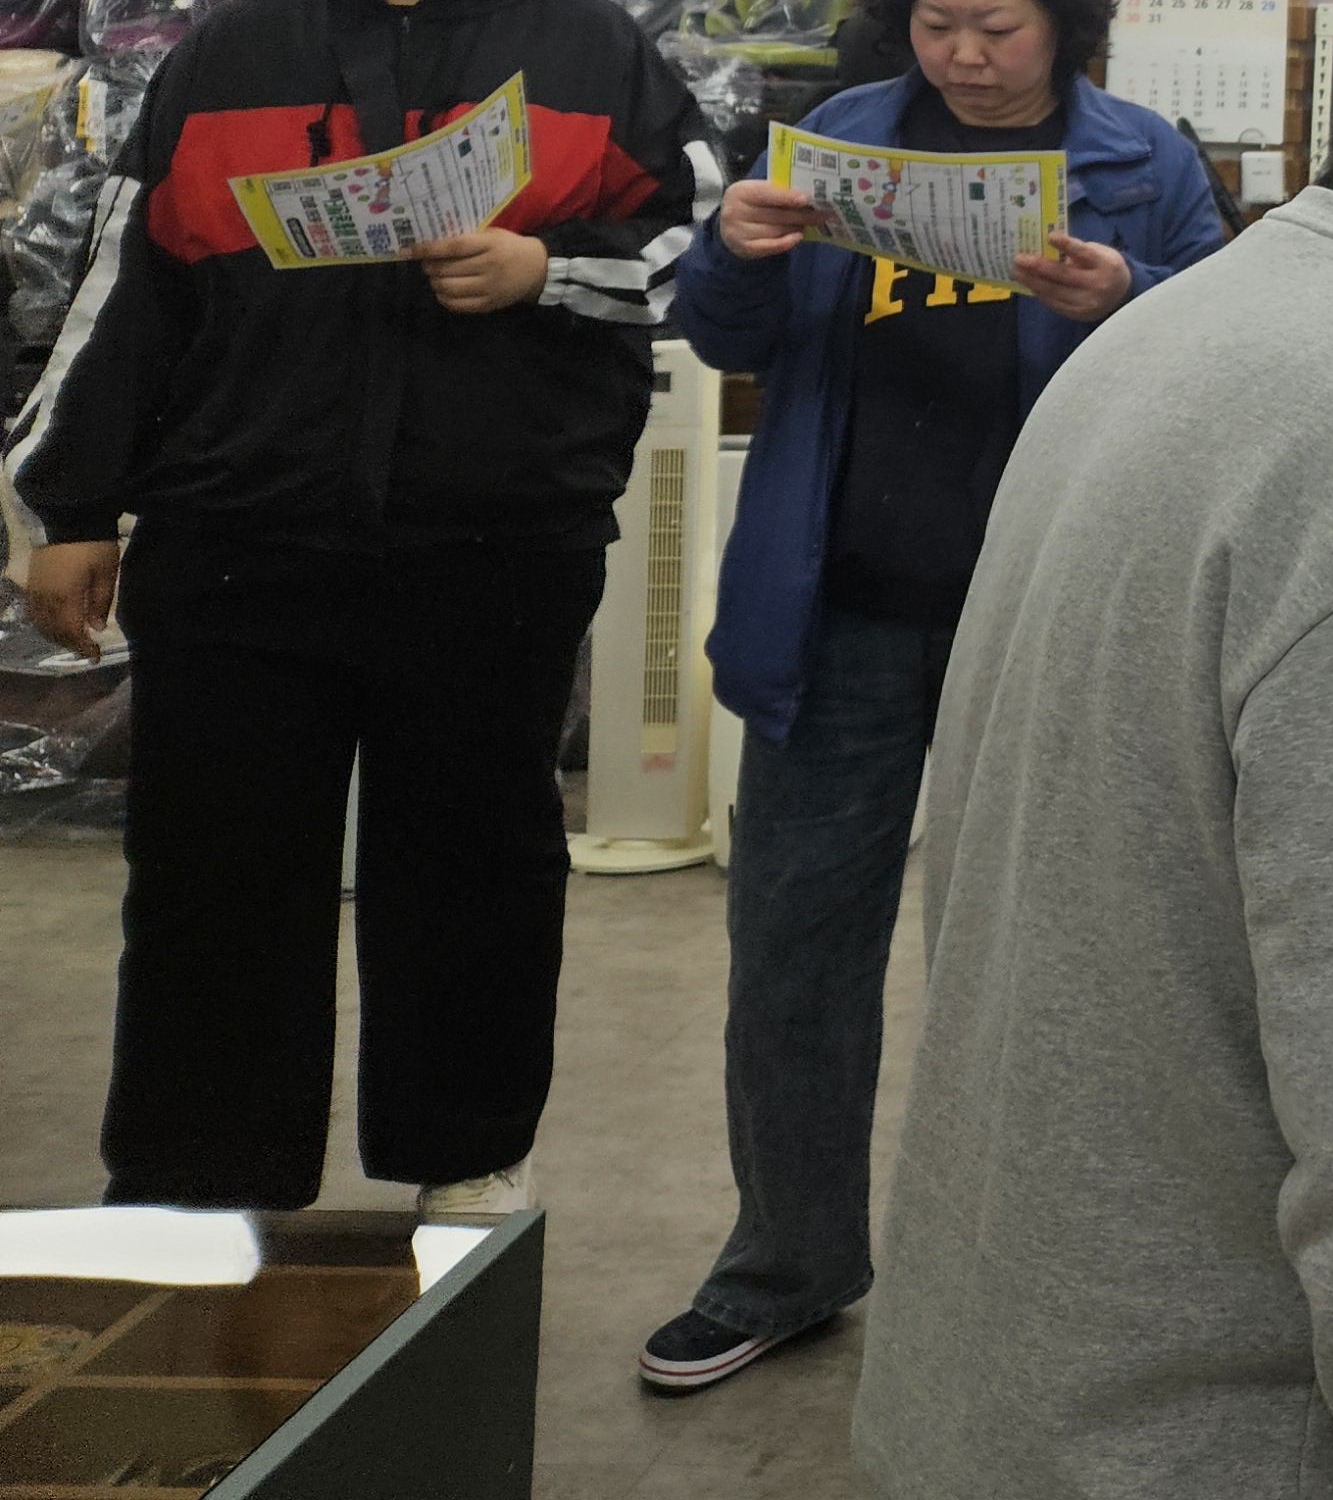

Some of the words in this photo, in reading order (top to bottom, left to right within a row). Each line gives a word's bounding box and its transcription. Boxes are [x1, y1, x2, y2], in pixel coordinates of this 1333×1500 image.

[1171, 0, 1186, 8] 25
[1194, 0, 1209, 9] 26
[1216, 0, 1231, 9] 27
[1239, 1, 1253, 10] 28
[1261, 1, 1275, 11] 29
[1126, 13, 1140, 23] 30
[1148, 14, 1162, 23] 31
[1195, 47, 1202, 56] 4
